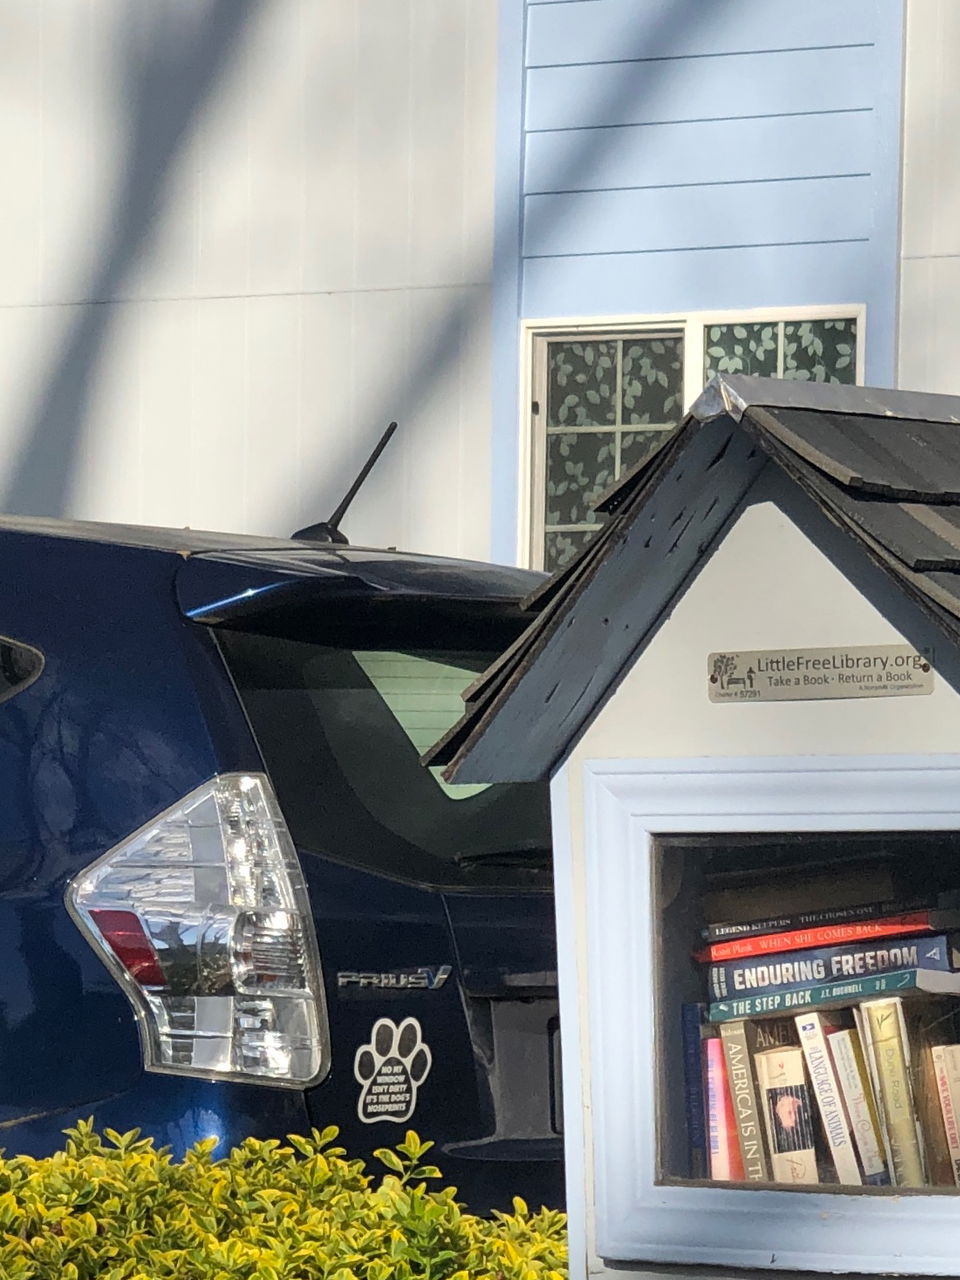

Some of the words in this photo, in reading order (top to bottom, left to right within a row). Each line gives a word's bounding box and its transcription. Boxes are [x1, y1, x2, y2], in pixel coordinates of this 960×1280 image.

[757, 654, 922, 672] LittleFreeLibrary.org
[767, 676, 791, 687] Take
[794, 677, 800, 686] a
[803, 674, 830, 686] Book
[838, 672, 873, 684] Return
[877, 674, 883, 682] a
[886, 670, 912, 682] Book
[715, 924, 750, 936] LEGEND
[759, 936, 792, 949] WHEN
[794, 934, 812, 944] SHE
[817, 928, 853, 941] COMES
[856, 925, 883, 935] BACK
[733, 959, 826, 991] ENDURING
[831, 946, 919, 976] FREEDOM
[337, 972, 427, 988] PRIUS
[733, 1000, 752, 1016] THE
[755, 995, 781, 1012] STEP
[785, 990, 812, 1007] BACK
[381, 1065, 392, 1074] NO
[393, 1065, 404, 1074] MY
[809, 1050, 833, 1096] LANGUAGE
[376, 1074, 406, 1084] WINDOW
[728, 1043, 750, 1119] AMERICA
[389, 1084, 408, 1093] DIRTY
[892, 1080, 903, 1110] Road
[378, 1094, 390, 1103] THE
[822, 1095, 835, 1108] OF
[367, 1103, 407, 1113] NOSEPRINTS
[742, 1122, 756, 1137] IS
[824, 1107, 847, 1148] ANIMALS
[744, 1141, 759, 1160] IN
